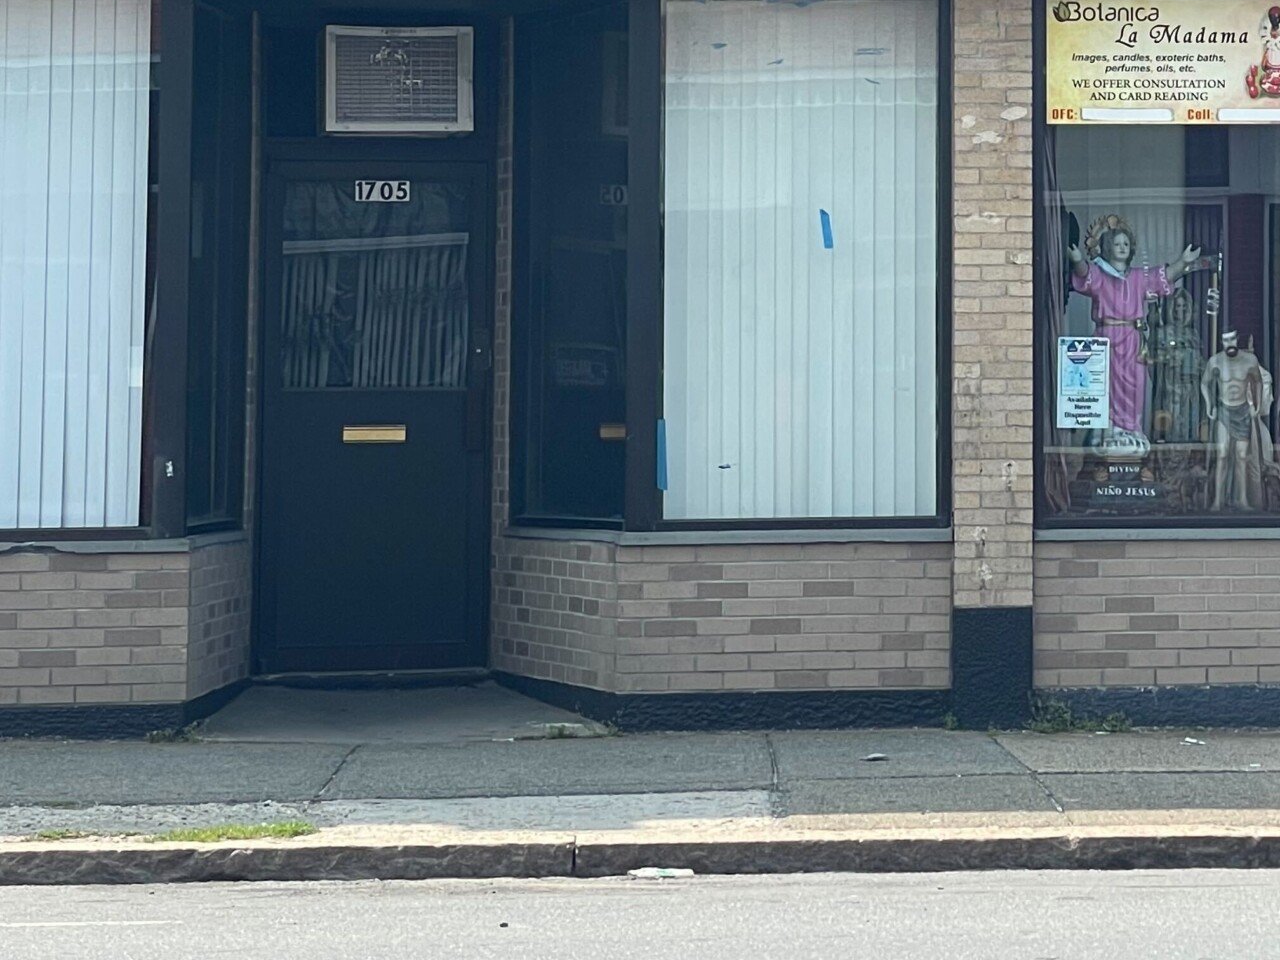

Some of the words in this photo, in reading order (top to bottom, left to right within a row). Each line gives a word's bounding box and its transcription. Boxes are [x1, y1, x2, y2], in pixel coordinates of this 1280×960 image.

[1067, 1, 1159, 22] Botanica
[1115, 23, 1138, 48] La
[1149, 24, 1249, 45] Madama
[1071, 53, 1109, 63] Images,
[1112, 53, 1152, 63] candles,
[1155, 53, 1194, 62] exoteric
[1196, 53, 1226, 63] baths,
[1104, 64, 1153, 74] perfumes,
[1156, 64, 1176, 73] oils,
[1179, 65, 1196, 73] etc.
[1072, 79, 1090, 88] WE
[1093, 79, 1132, 88] OFFER
[1134, 79, 1226, 89] CONSULTATION
[1089, 92, 1116, 101] AND
[1119, 92, 1151, 101] CARD
[1154, 92, 1208, 101] READING
[1052, 109, 1078, 120] OFC:
[356, 181, 407, 200] 1705
[1097, 485, 1122, 496] NIÑO
[1125, 487, 1156, 496] JESUS
